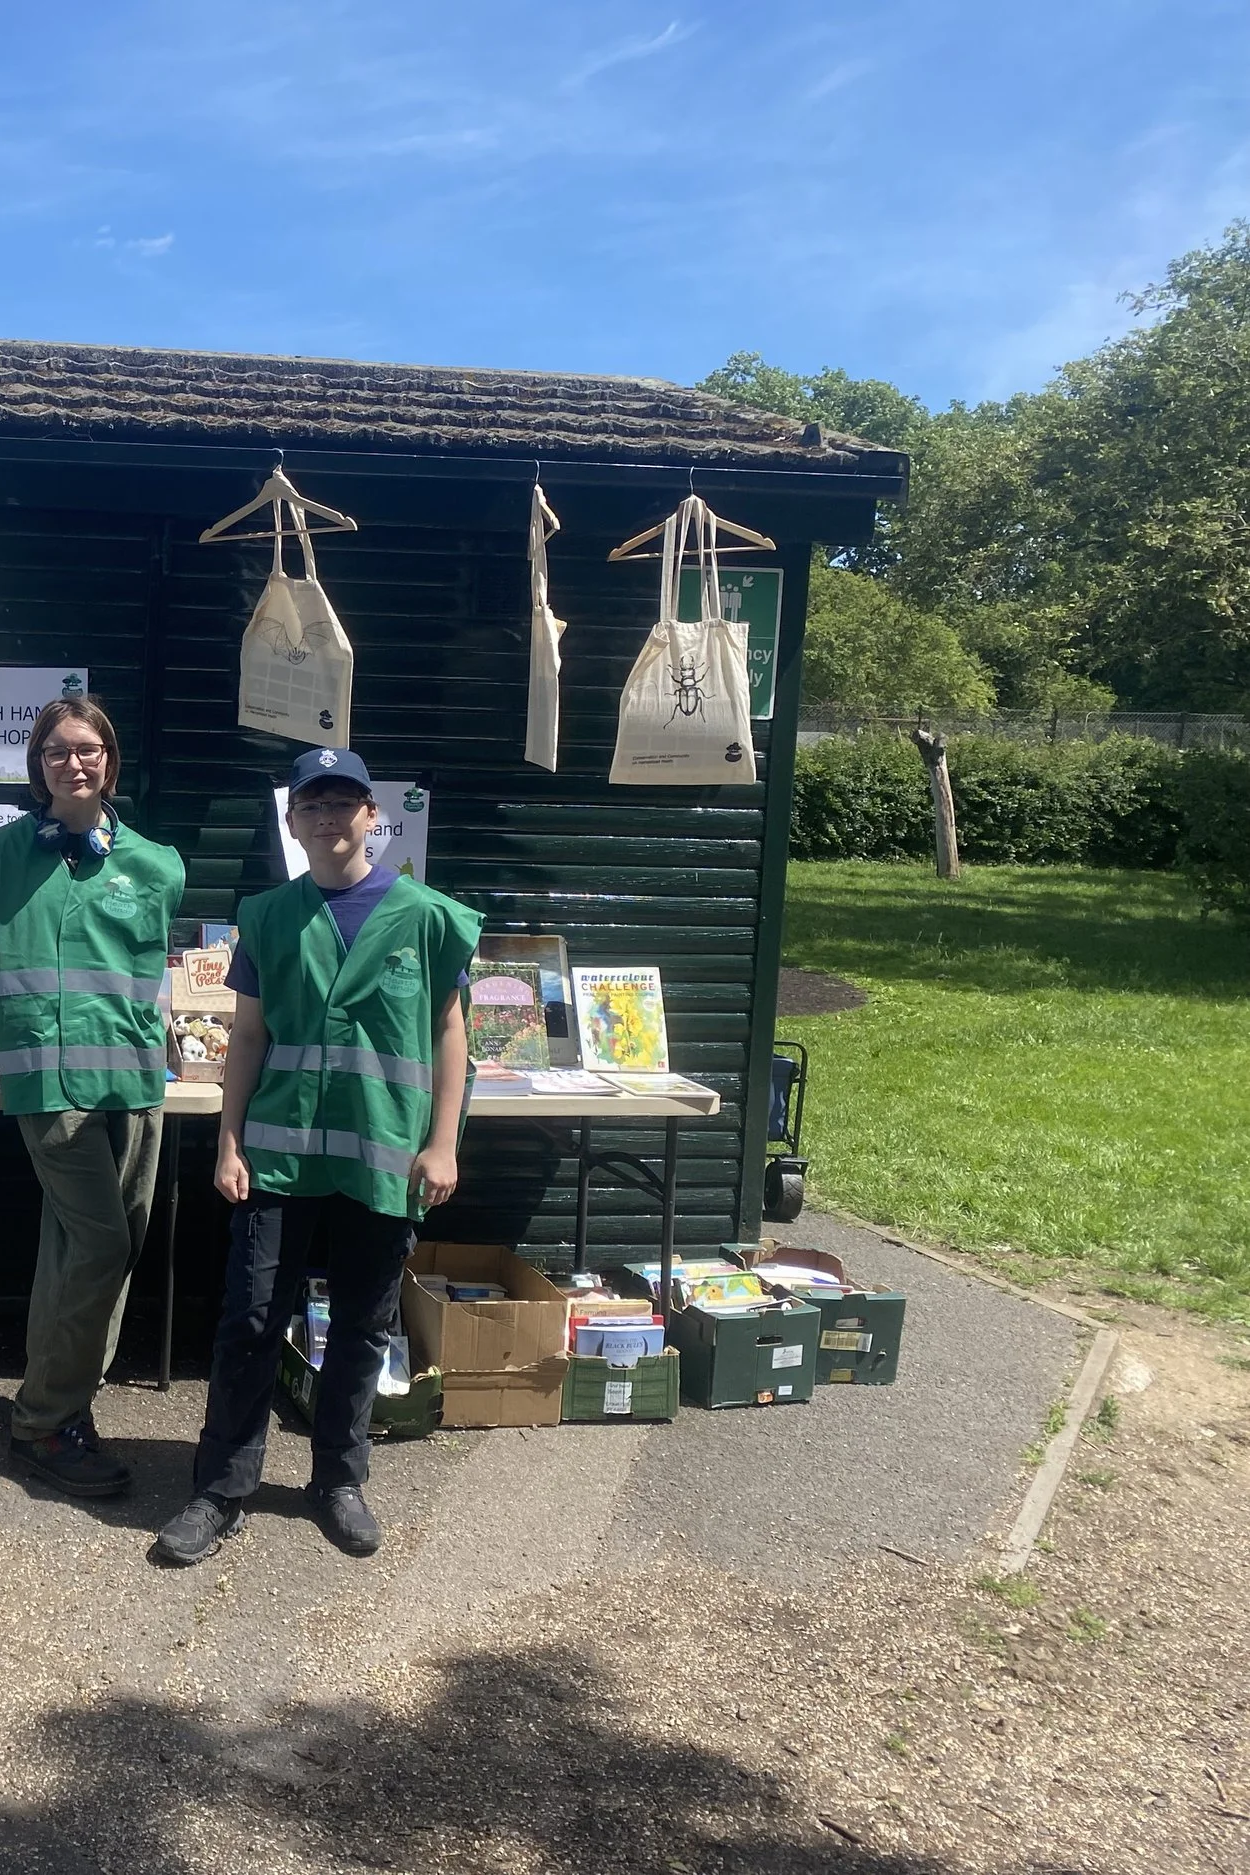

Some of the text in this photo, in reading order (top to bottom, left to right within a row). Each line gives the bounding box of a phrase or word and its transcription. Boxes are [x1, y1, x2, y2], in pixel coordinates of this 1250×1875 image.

[370, 821, 403, 836] and
[192, 957, 225, 977] Tiny
[196, 973, 223, 987] Pets
[581, 973, 654, 981] watercolour
[581, 983, 656, 991] CHALLENGE
